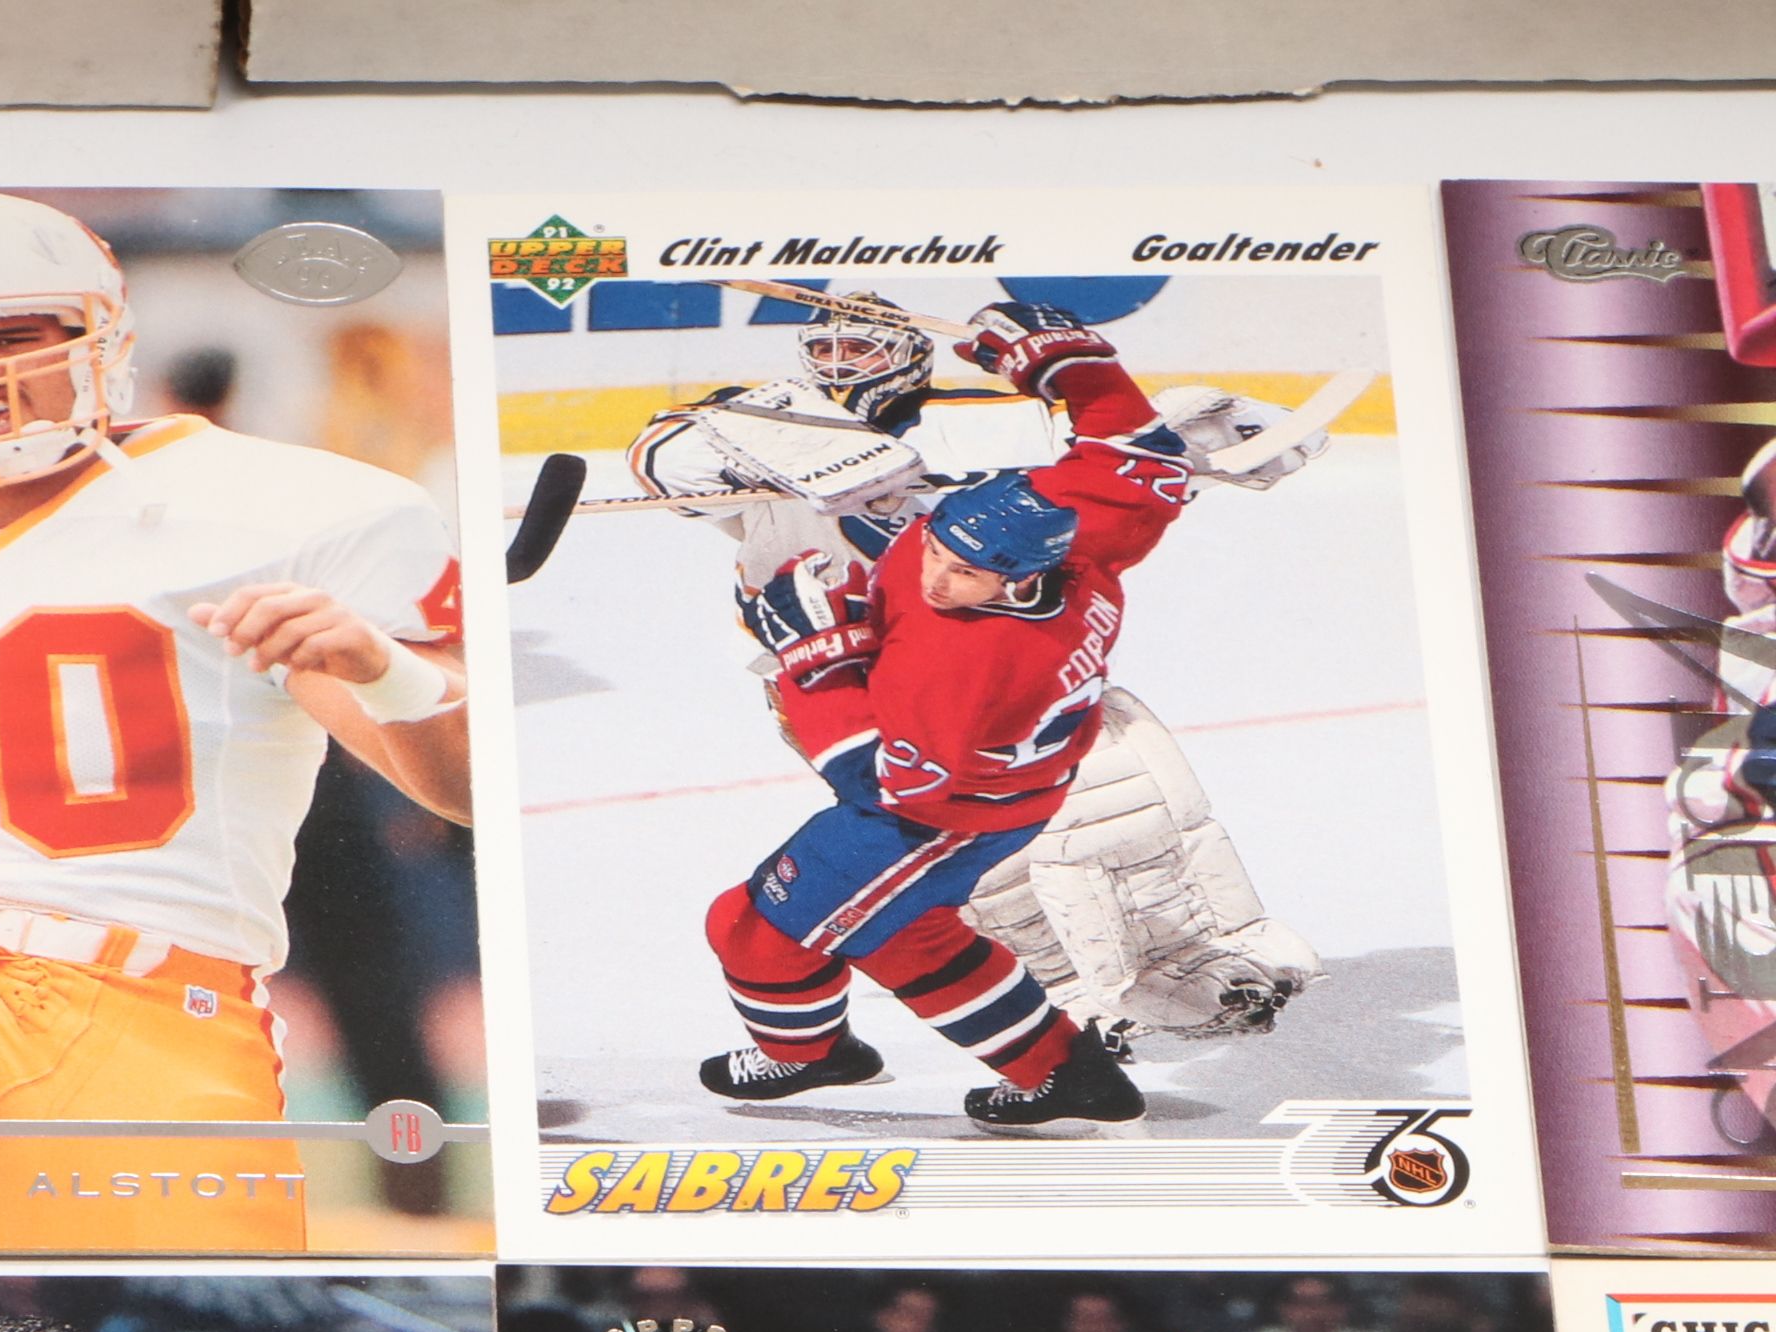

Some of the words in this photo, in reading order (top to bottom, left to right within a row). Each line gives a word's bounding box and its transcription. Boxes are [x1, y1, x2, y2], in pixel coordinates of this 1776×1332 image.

[543, 226, 568, 238] 91
[489, 240, 625, 258] UPPER
[659, 237, 761, 268] Clint
[769, 235, 1004, 268] Malarchuk
[1131, 233, 1382, 263] Goaltender
[1520, 226, 1686, 283] Classic
[547, 277, 576, 290] 92
[799, 443, 891, 485] VAUGHN
[390, 1112, 421, 1154] FB
[27, 1171, 306, 1199] ALSTOTT
[544, 1147, 921, 1215] SABRES
[1396, 1156, 1438, 1185] NHL
